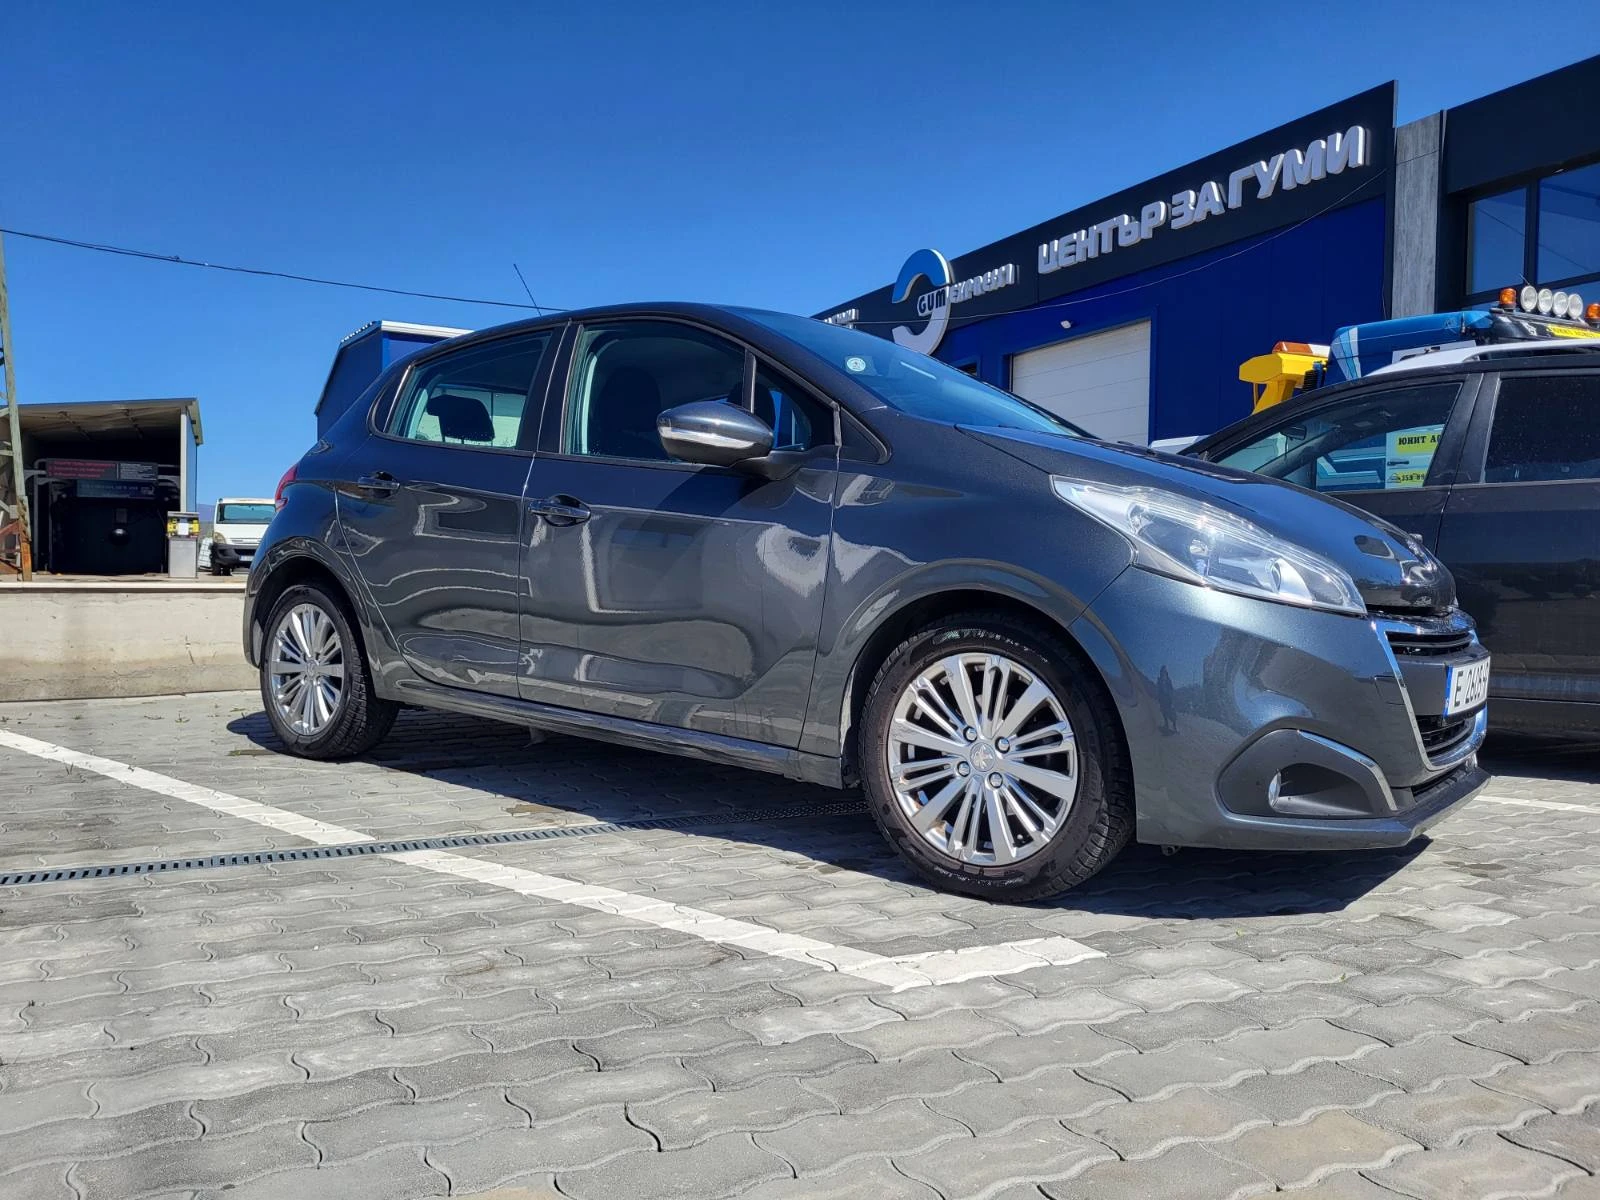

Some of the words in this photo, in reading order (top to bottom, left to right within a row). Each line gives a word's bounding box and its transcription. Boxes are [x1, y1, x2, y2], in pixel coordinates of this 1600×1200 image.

[1038, 200, 1166, 274] ЦЕНТЪР
[1171, 181, 1226, 229] ЗА
[1228, 125, 1366, 208] ГУМИ
[918, 289, 946, 313] GUM
